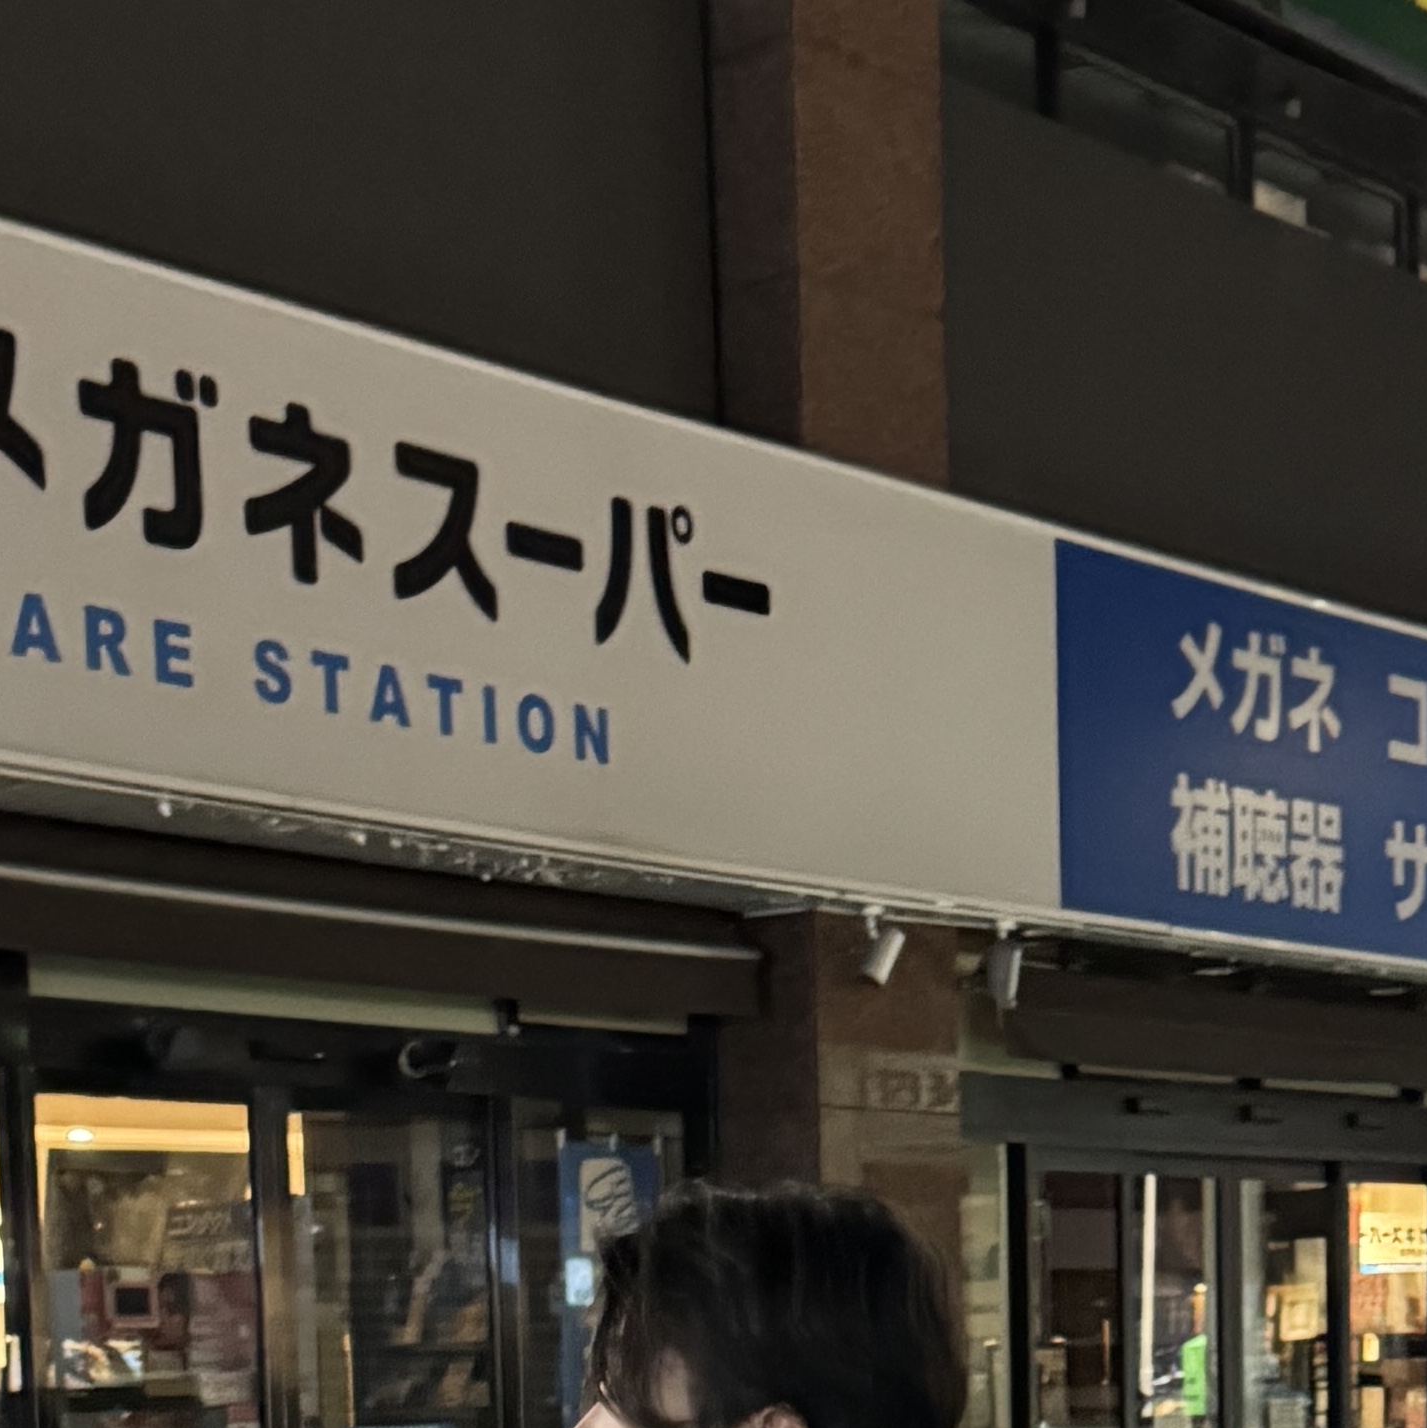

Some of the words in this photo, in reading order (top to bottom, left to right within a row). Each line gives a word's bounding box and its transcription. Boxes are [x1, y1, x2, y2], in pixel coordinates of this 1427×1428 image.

[253, 639, 611, 766] STATION
[1171, 621, 1343, 753] メガネ
[1170, 772, 1346, 914] 補聴器
